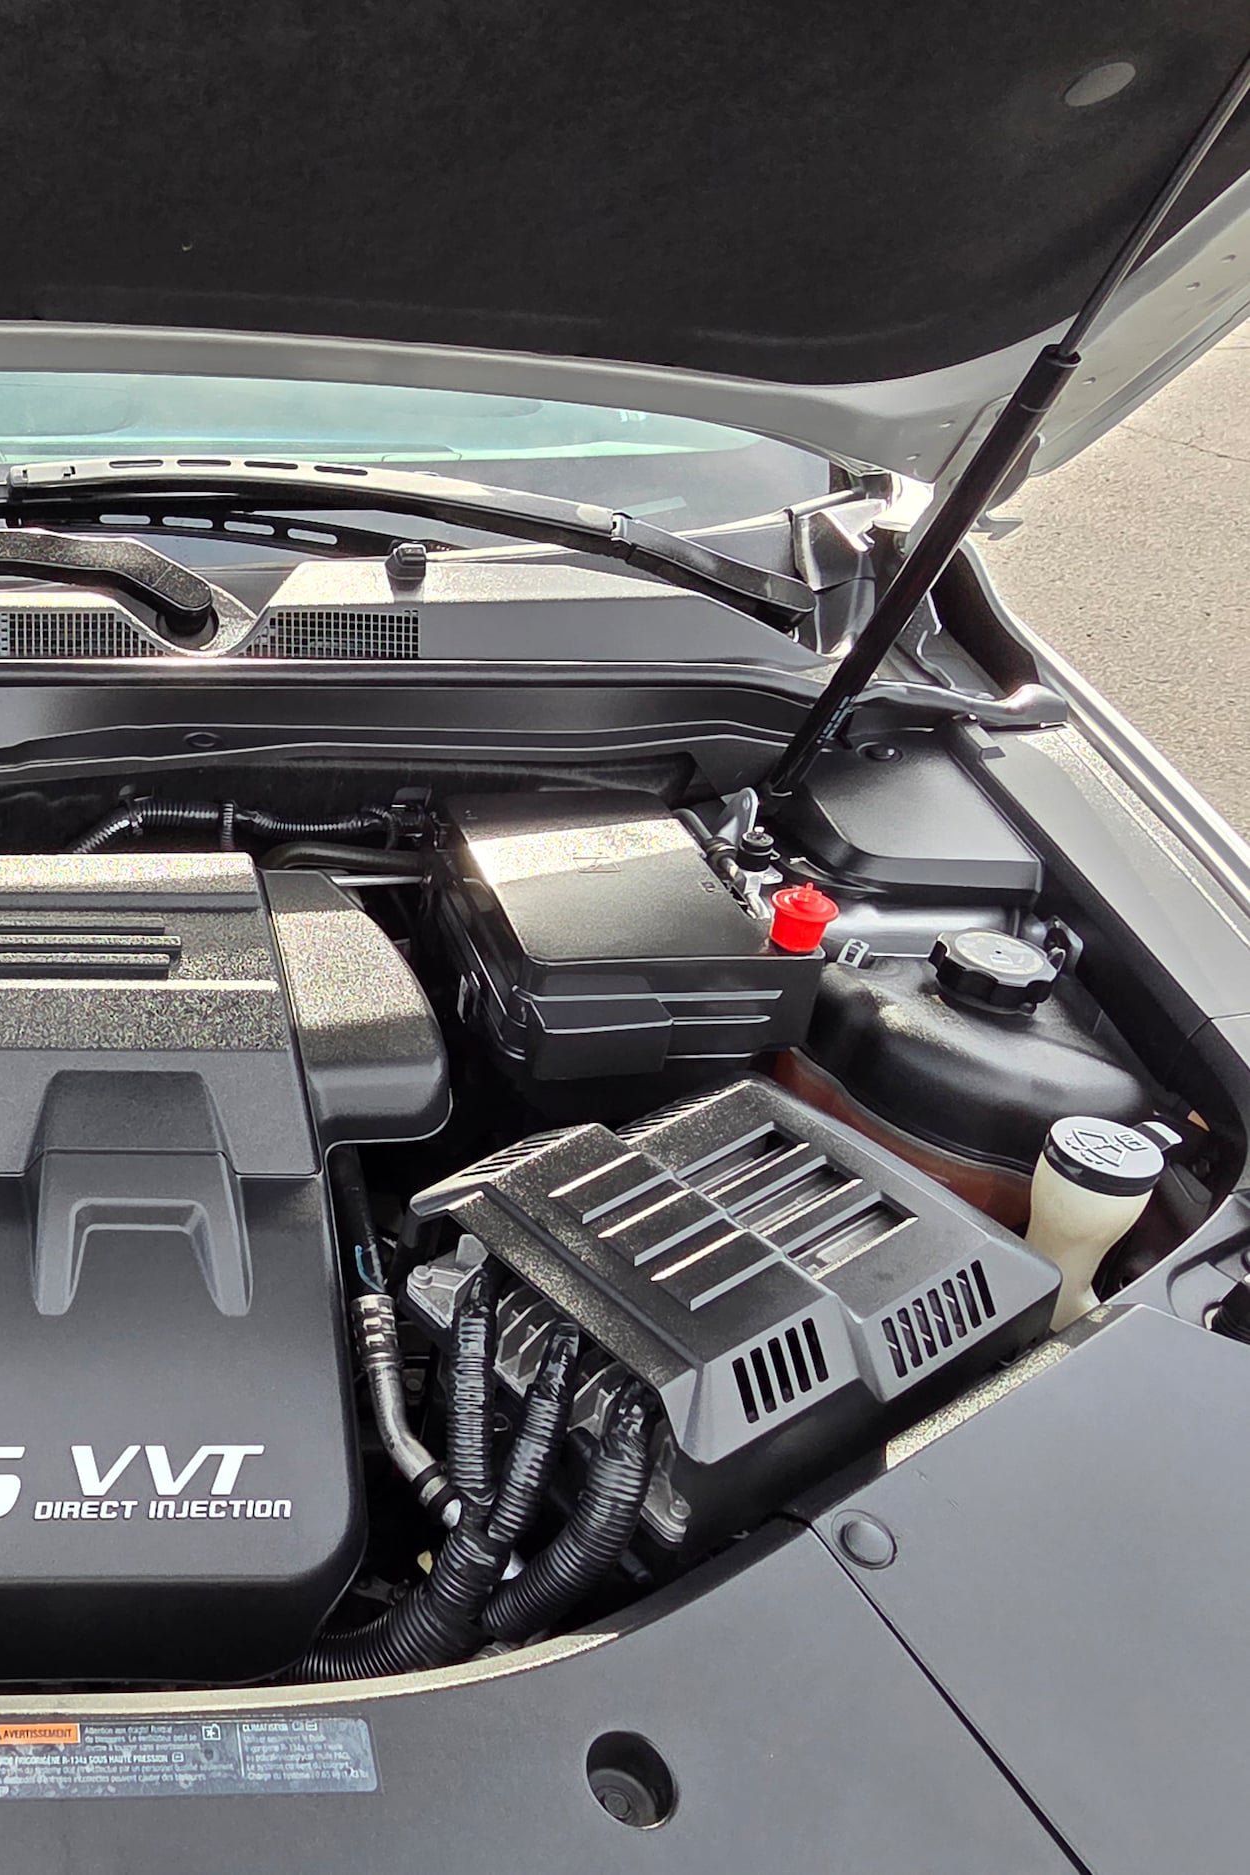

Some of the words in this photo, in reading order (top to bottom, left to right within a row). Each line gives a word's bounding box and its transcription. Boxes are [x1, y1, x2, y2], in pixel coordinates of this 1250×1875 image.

[70, 1444, 265, 1496] VVT
[34, 1500, 138, 1520] DIRECT
[148, 1499, 292, 1519] INJECTION
[3, 1729, 72, 1738] AVERTISSEMENT
[133, 1754, 168, 1763] PRESSION
